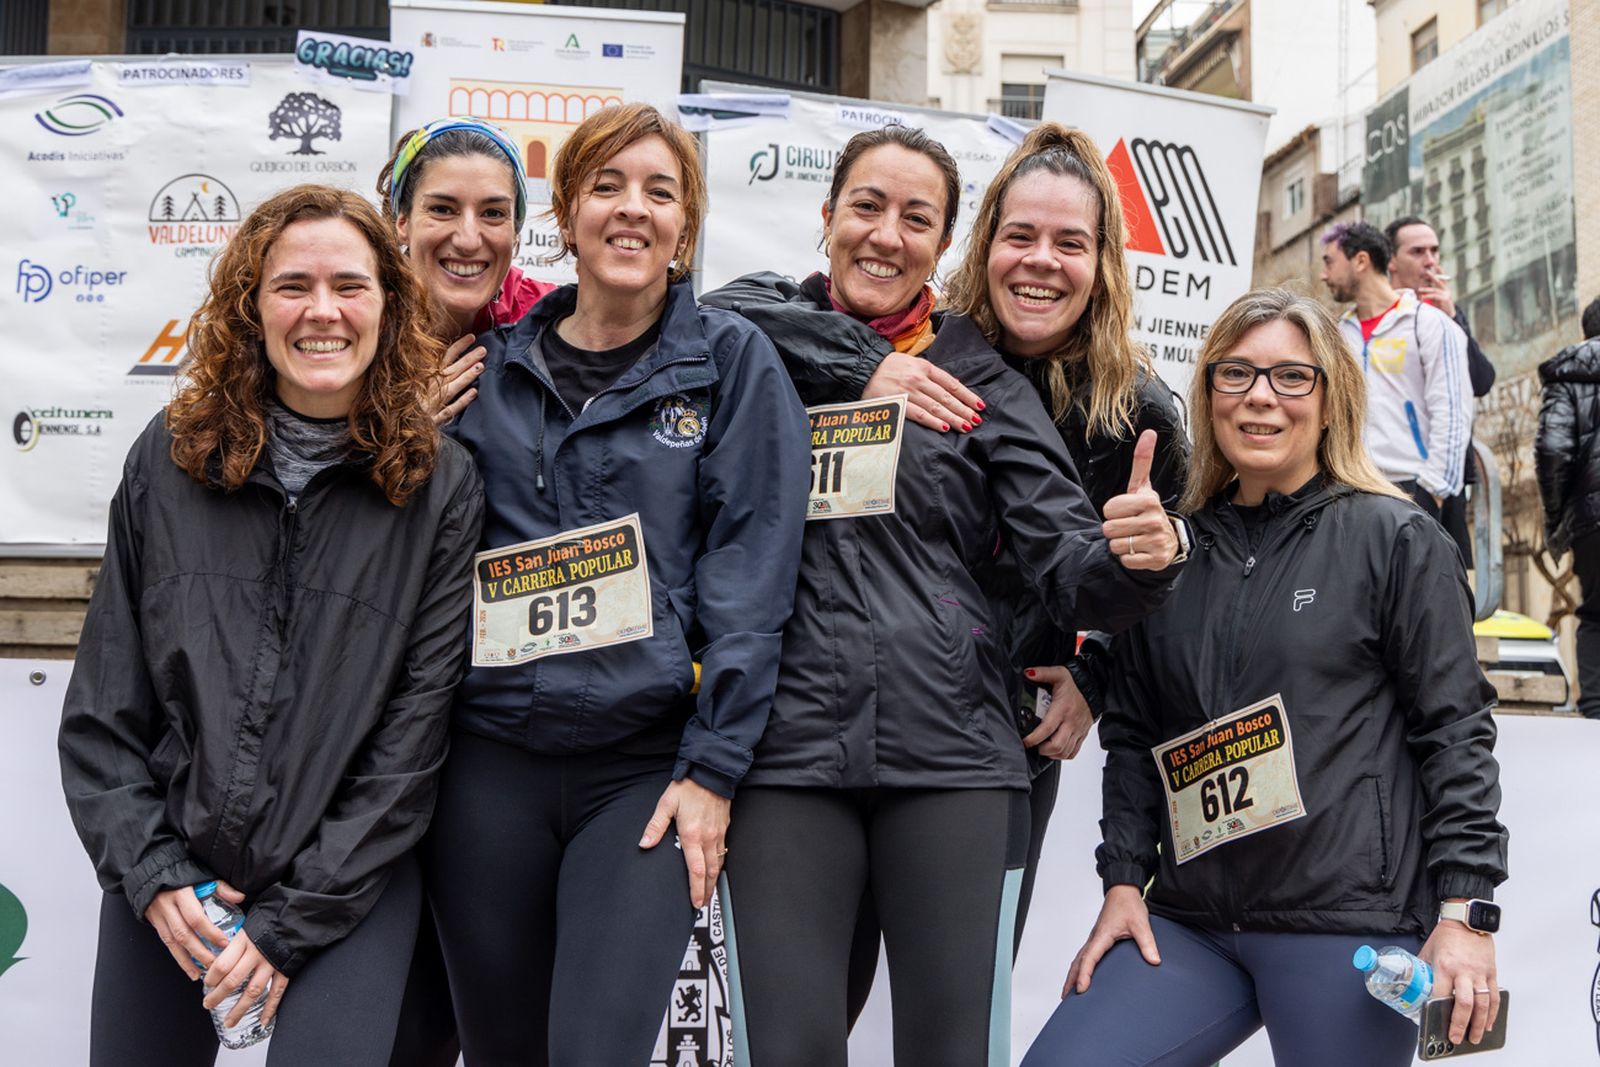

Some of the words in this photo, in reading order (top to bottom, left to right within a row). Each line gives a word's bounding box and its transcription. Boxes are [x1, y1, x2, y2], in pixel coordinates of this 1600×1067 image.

[123, 67, 244, 80] PATROCINADORES
[296, 38, 414, 77] GRACIAS!
[1457, 76, 1469, 96] DE
[1470, 62, 1490, 87] LOS
[294, 160, 311, 172] DEL
[59, 265, 128, 291] ofiper
[817, 413, 848, 428] Juan
[852, 409, 890, 424] Bosco
[832, 424, 892, 444] POPULAR
[652, 429, 694, 448] Valdepeñas
[694, 434, 702, 444] de
[488, 559, 512, 578] IES
[515, 553, 543, 572] San
[547, 543, 580, 566] Juan
[584, 531, 625, 555] Bosco
[488, 581, 498, 599] V
[502, 570, 566, 596] CARRERA
[569, 549, 634, 581] POPULAR
[529, 586, 597, 636] 613
[1169, 748, 1188, 768] IES
[1188, 740, 1206, 760] San
[1207, 727, 1234, 749] Juan
[1236, 712, 1272, 736] Bosco
[1171, 771, 1180, 788] V
[1182, 749, 1223, 783] CARRERA
[1224, 728, 1280, 762] POPULAR
[1200, 766, 1253, 823] 612
[713, 949, 728, 967] DE
